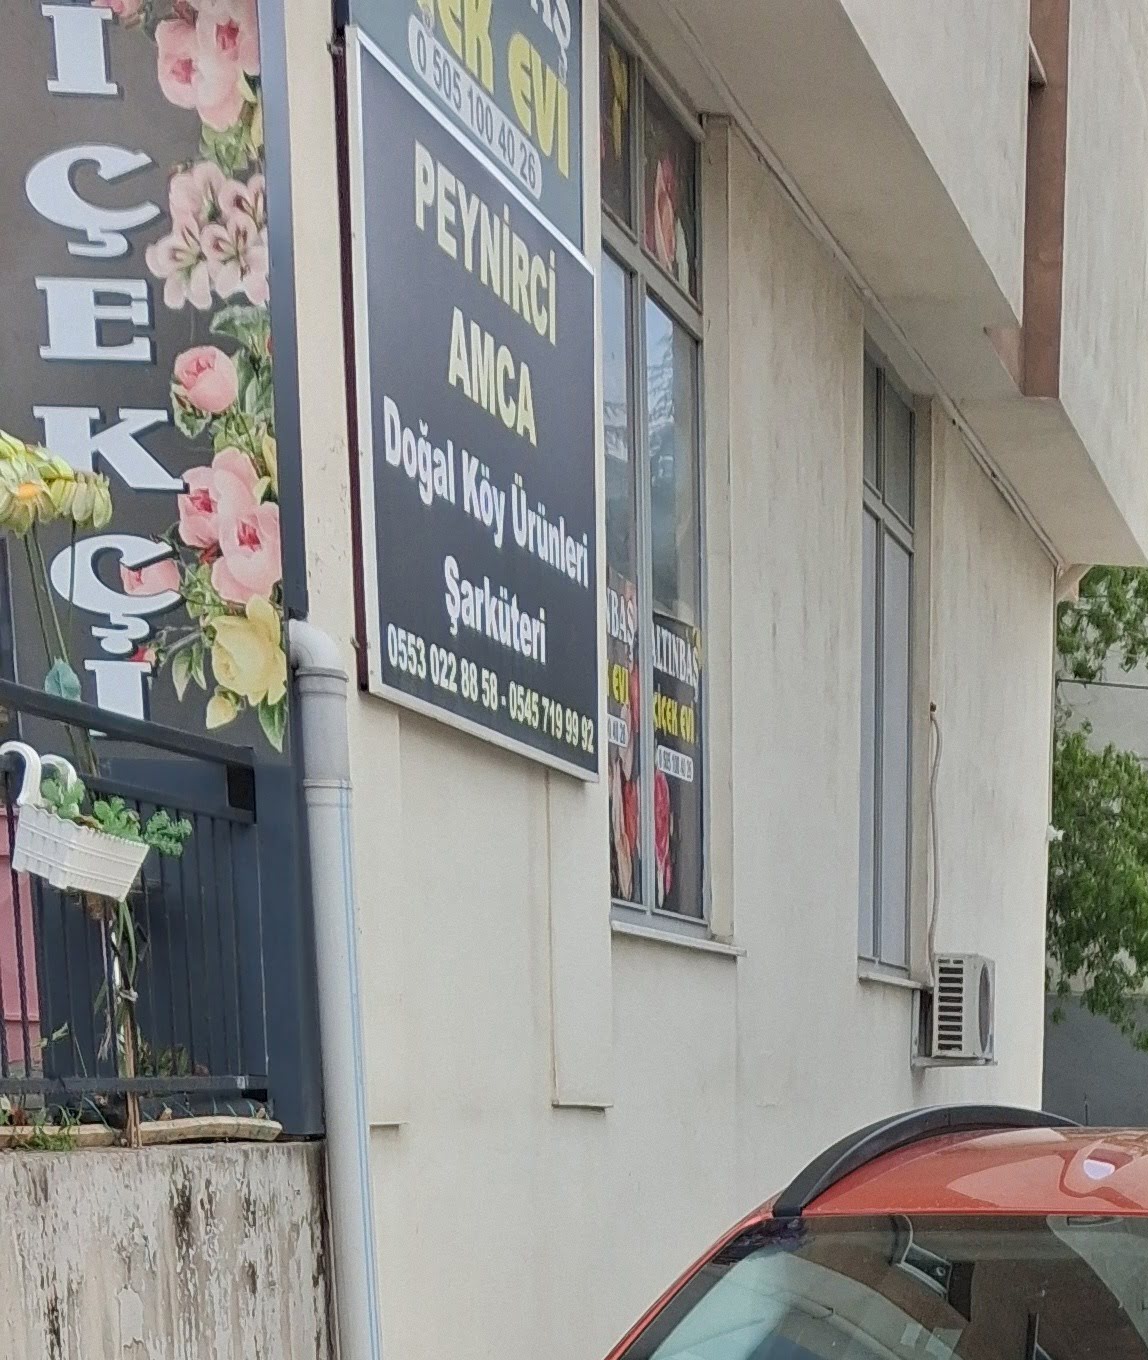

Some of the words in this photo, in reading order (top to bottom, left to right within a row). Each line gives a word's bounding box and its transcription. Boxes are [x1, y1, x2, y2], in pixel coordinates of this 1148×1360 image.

[416, 30, 427, 74] 0
[432, 48, 462, 111] 505
[468, 86, 494, 145] 100
[498, 121, 515, 168] 40
[519, 145, 536, 190] 26
[415, 139, 556, 346] PEYNİRCİ
[448, 306, 537, 447] AMCA
[384, 395, 455, 505] Doğal
[461, 449, 505, 549] Köy
[511, 472, 588, 589] Ürünleri
[444, 555, 546, 665] Şarküteri
[387, 622, 427, 679] 0553
[429, 643, 458, 693] 022
[460, 657, 479, 702] 88
[481, 666, 499, 711] 58
[509, 680, 539, 729] 0545
[542, 696, 564, 740] 719
[565, 707, 579, 747] 99
[581, 714, 595, 754] 92
